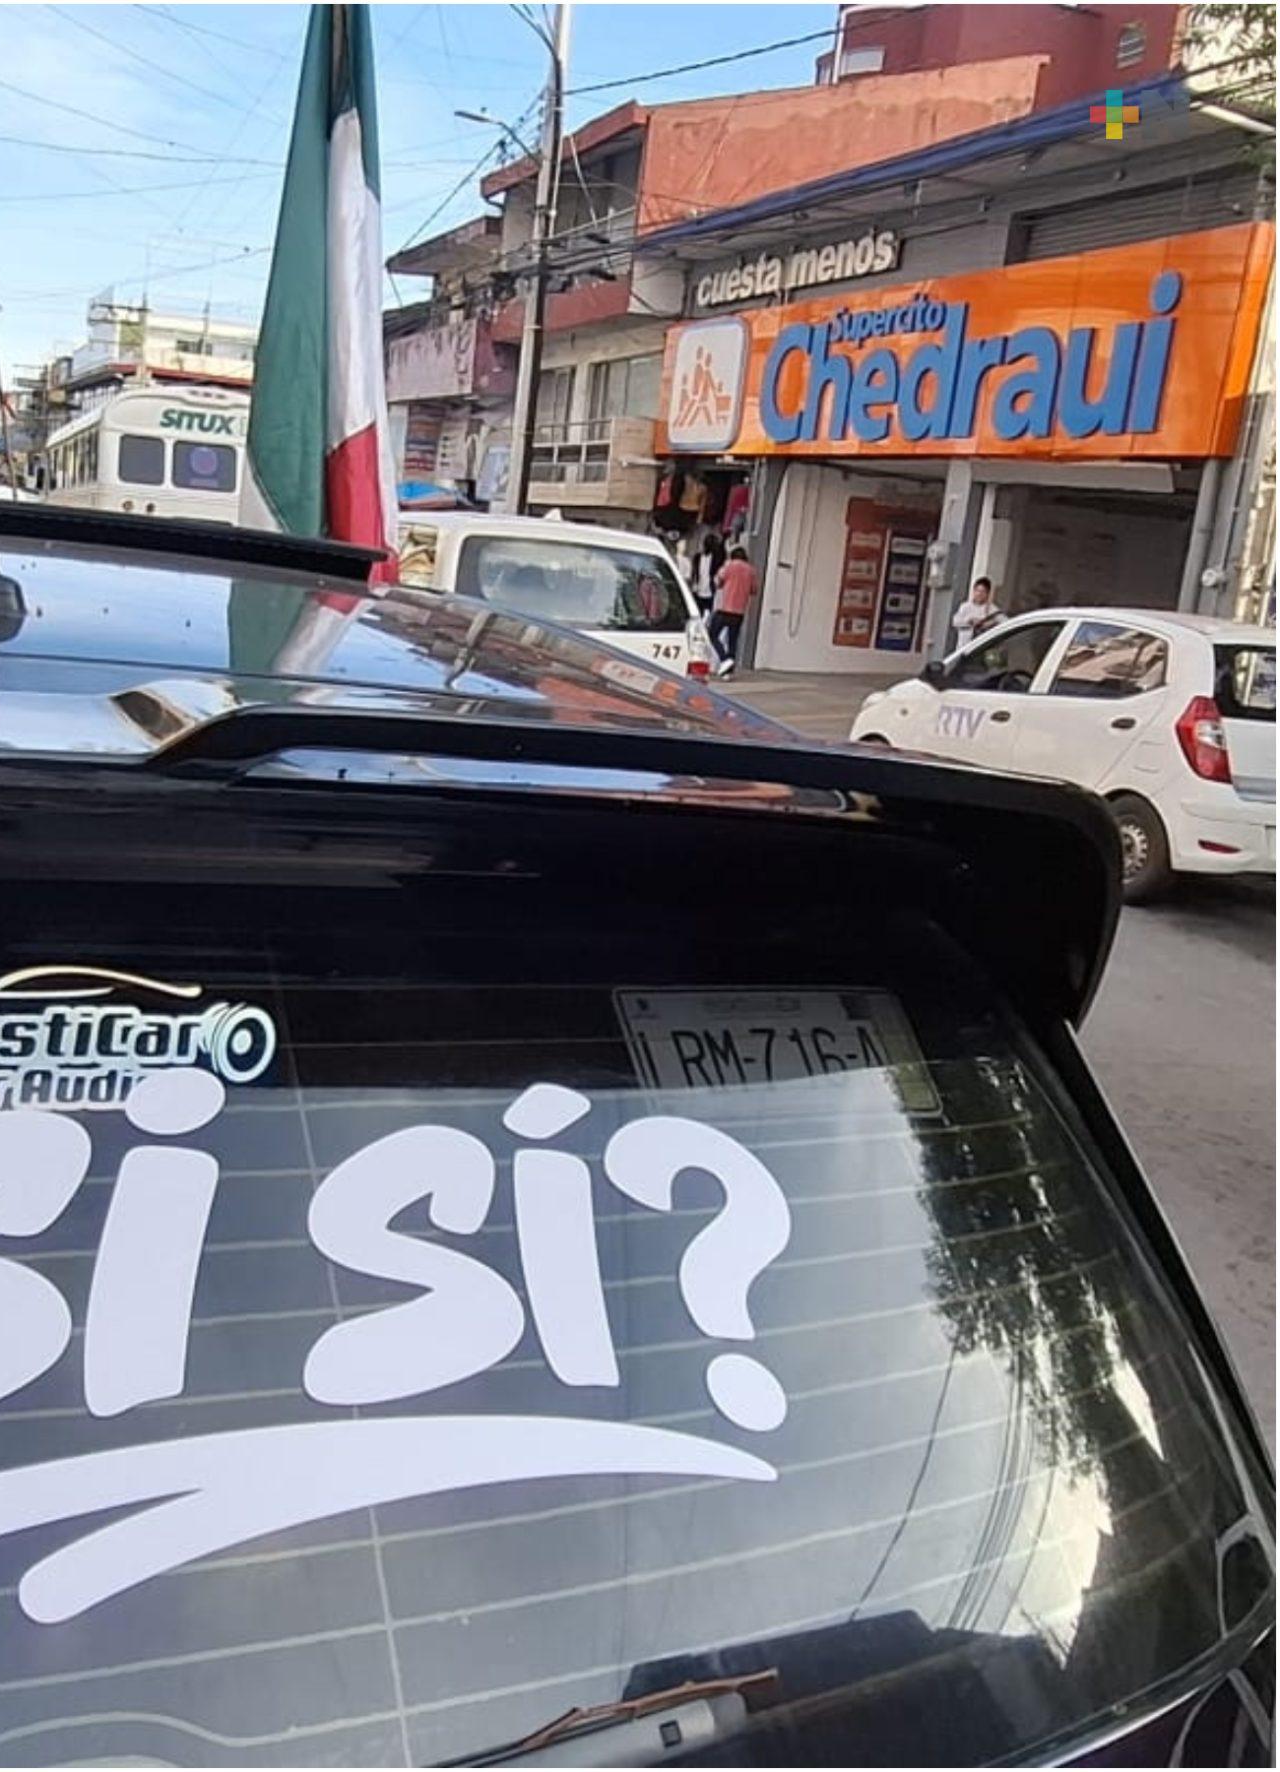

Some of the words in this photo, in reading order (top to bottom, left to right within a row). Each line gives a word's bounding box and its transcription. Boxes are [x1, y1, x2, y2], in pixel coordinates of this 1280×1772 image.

[697, 252, 782, 307] cuesta
[783, 230, 895, 289] menos
[829, 293, 949, 349] Supercito
[759, 268, 1184, 445] Chedraui
[159, 407, 236, 435] SITUX
[651, 642, 682, 660] 747
[935, 704, 987, 738] RTV
[19, 1068, 144, 1104] Audi
